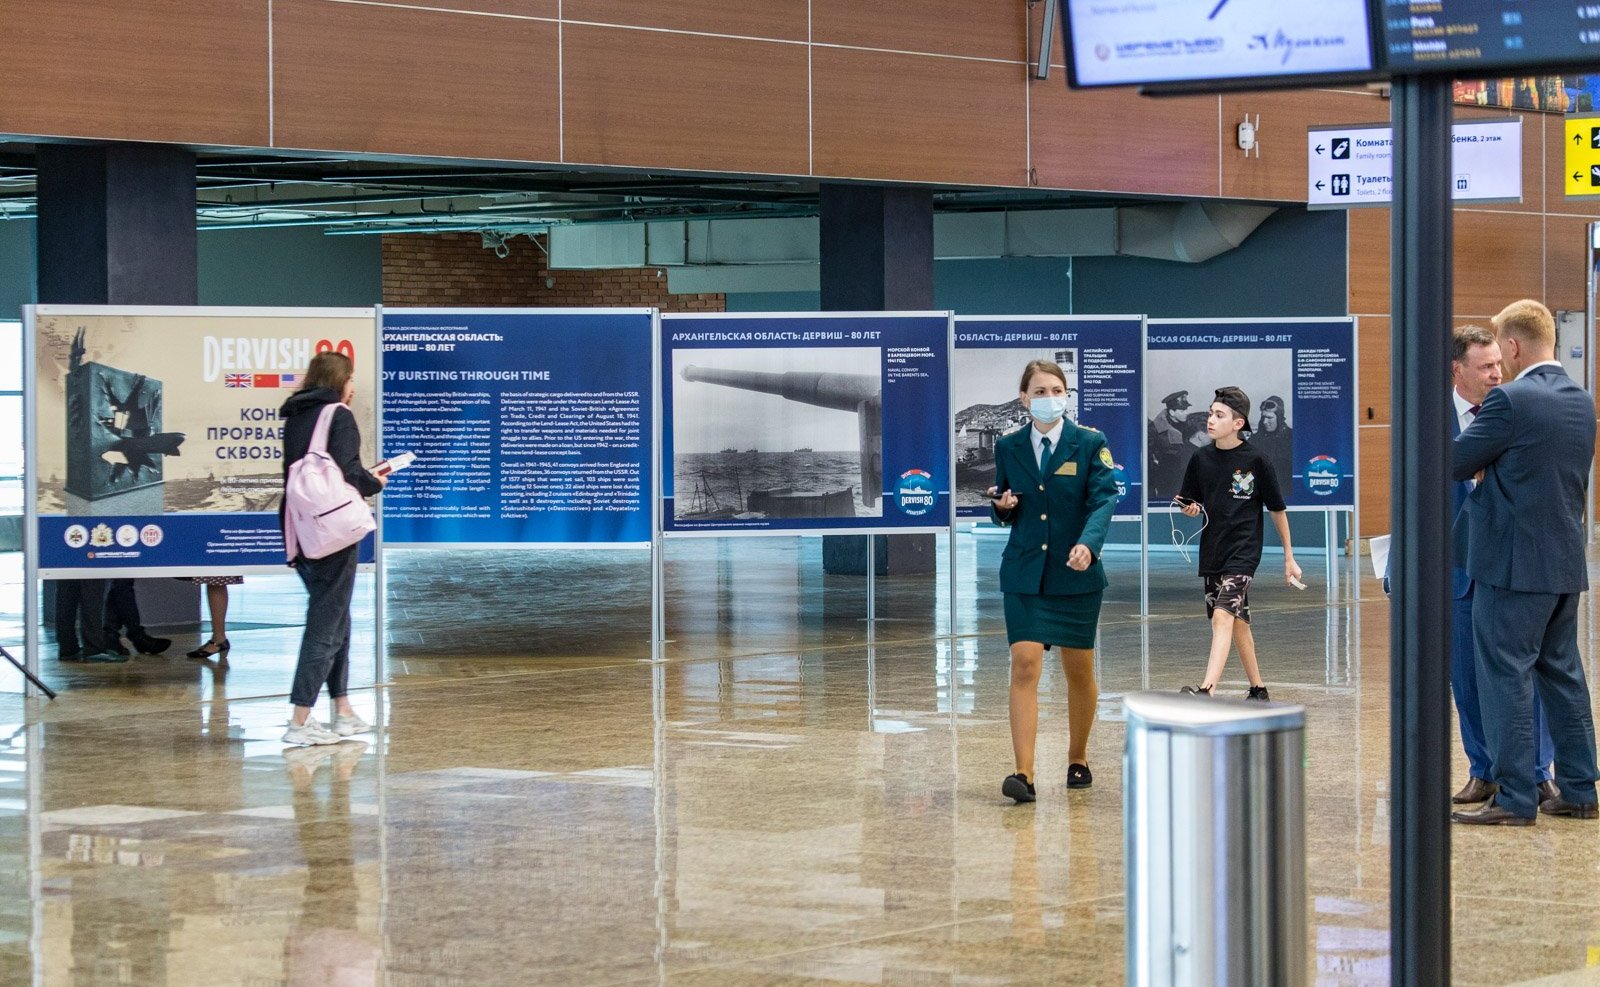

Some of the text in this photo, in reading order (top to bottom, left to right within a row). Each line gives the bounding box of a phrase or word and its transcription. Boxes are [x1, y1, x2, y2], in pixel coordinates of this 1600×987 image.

[1356, 139, 1392, 147] Комната
[1356, 175, 1393, 185] Туалеты
[672, 332, 752, 340] АРХАНГЕЛЬСКАЯ
[754, 332, 801, 340] ОБЛАСТЬ:
[802, 332, 842, 341] ДЕРВИШ
[851, 331, 862, 339] 80
[863, 331, 881, 339] ЛЕТ
[959, 333, 1003, 341] ОБЛАСТЬ:
[1004, 333, 1042, 342] ДЕРВИШ
[1050, 333, 1060, 341] 80
[1222, 335, 1258, 343] ДЕРВИШ
[203, 336, 310, 382] DERVISH
[399, 371, 458, 380] BURSTING
[459, 371, 519, 380] THROUGH
[521, 371, 550, 380] TIME
[241, 408, 288, 421] КОН
[216, 446, 282, 460] СКВОЗЬ
[902, 496, 933, 506] DERVISH 80
